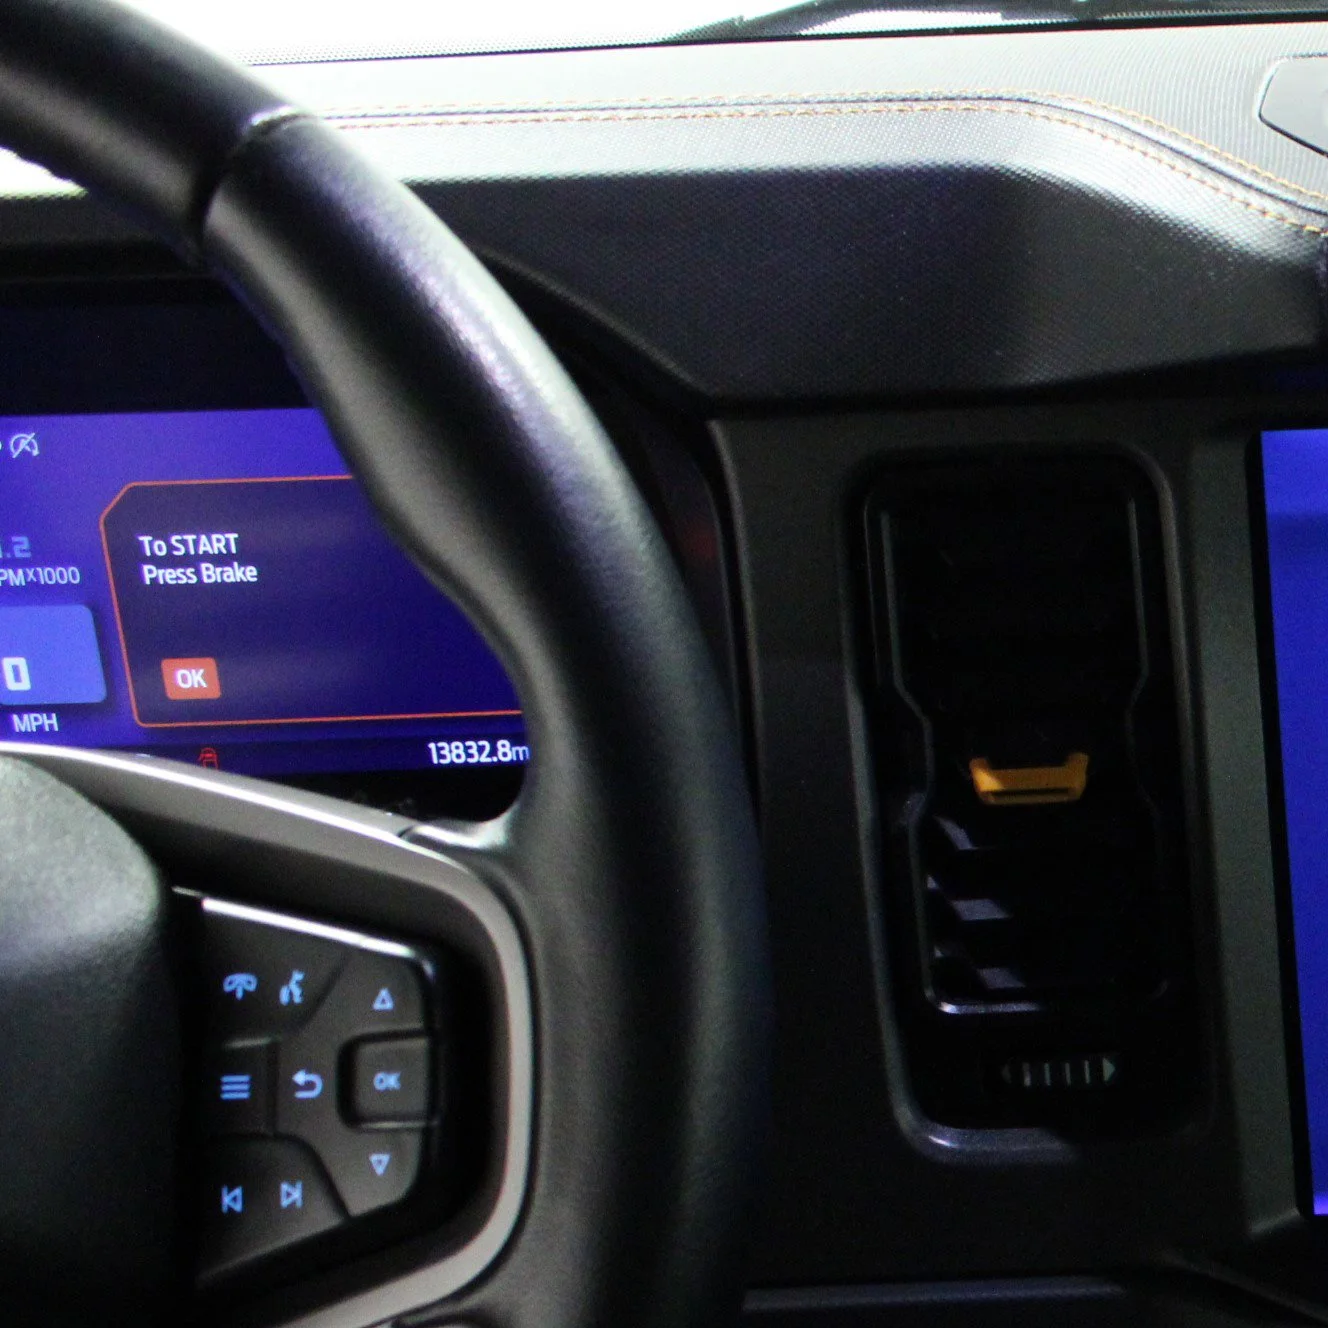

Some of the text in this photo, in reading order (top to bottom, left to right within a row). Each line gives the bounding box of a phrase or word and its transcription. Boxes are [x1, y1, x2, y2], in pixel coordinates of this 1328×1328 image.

[0, 536, 31, 558] .2
[139, 533, 238, 556] To START
[142, 562, 257, 585] Press Brake
[3, 657, 31, 690] 0
[176, 668, 207, 688] OK
[13, 713, 58, 732] MPH
[373, 1071, 401, 1091] OK
